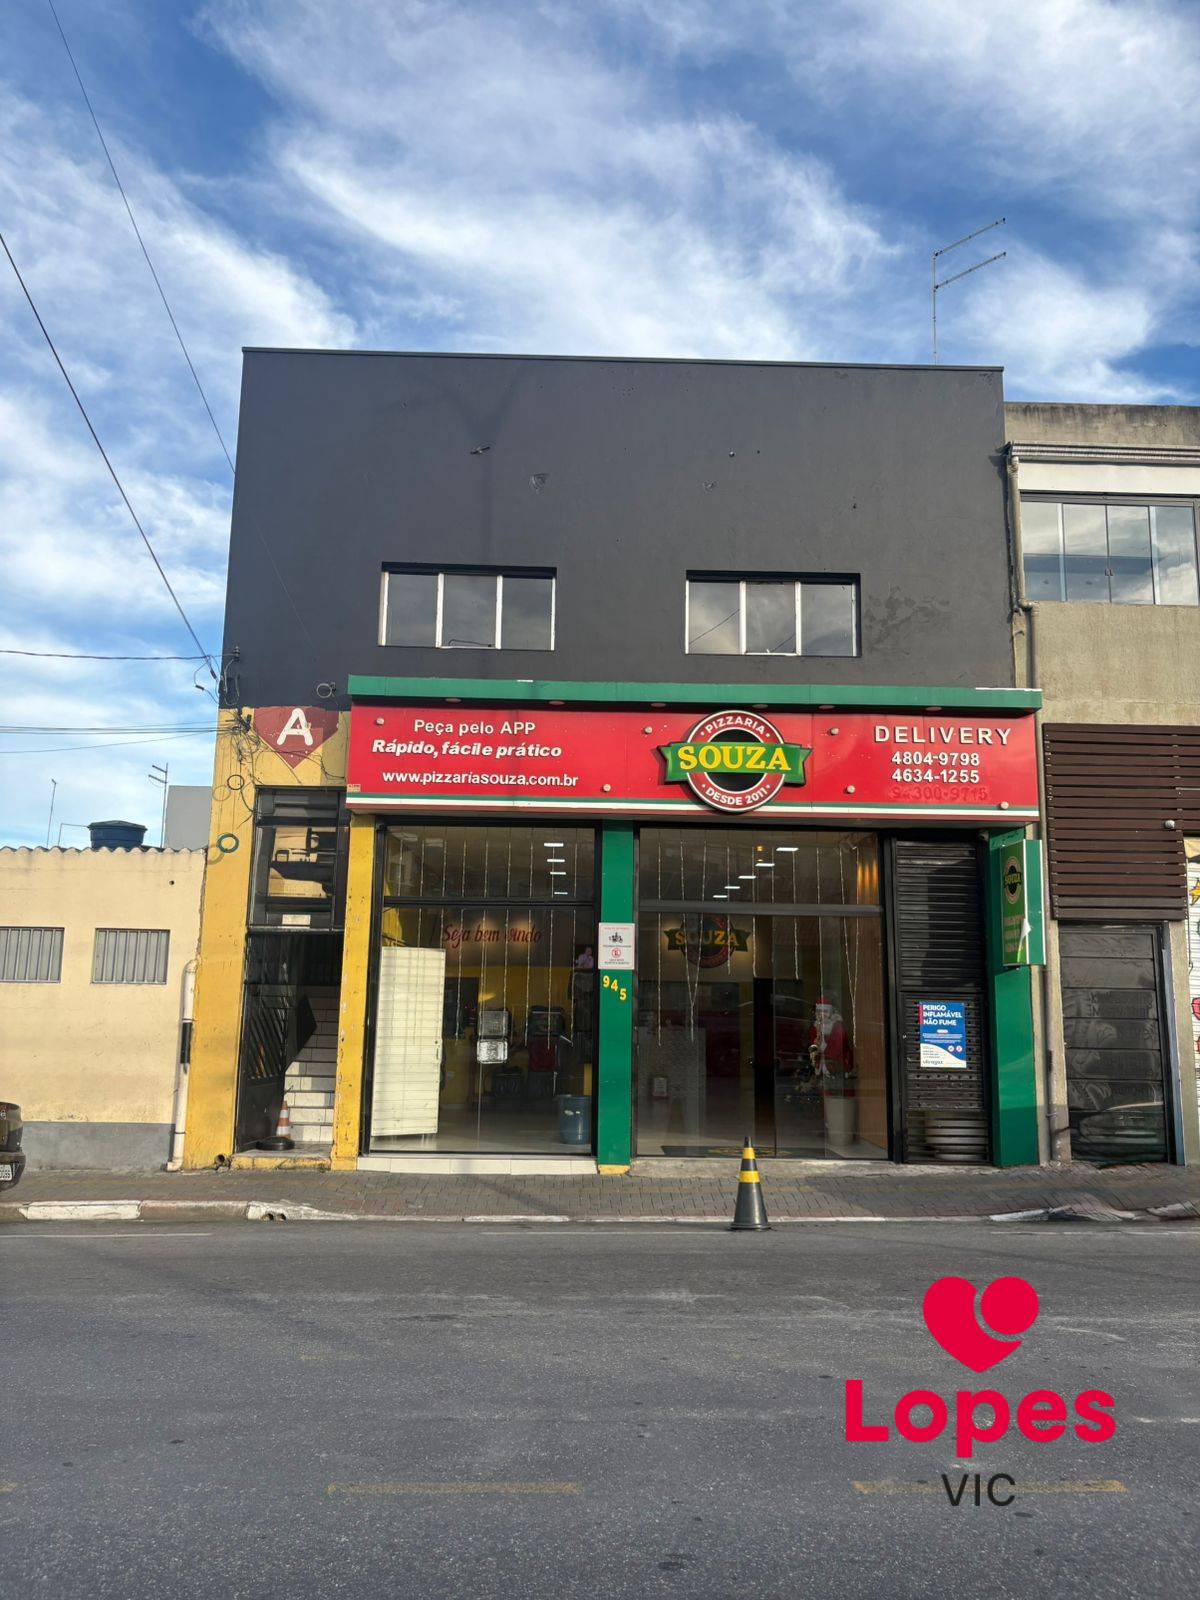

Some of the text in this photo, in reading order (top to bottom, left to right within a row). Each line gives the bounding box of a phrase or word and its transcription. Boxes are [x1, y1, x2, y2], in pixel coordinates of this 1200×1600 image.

[276, 707, 314, 746] A
[414, 719, 536, 736] Peça pelo APP
[705, 716, 766, 736] PIZZARIA
[875, 725, 1011, 745] DELIVERY
[372, 739, 438, 758] Rápido,
[496, 742, 562, 760] prático
[677, 745, 791, 771] SOUZA
[891, 751, 980, 766] 4804-9798
[382, 771, 579, 787] www.pizzariasouza.com.br
[891, 769, 980, 784] 4634-1255
[705, 787, 768, 806] DESDE 2011
[602, 975, 627, 1001] 945
